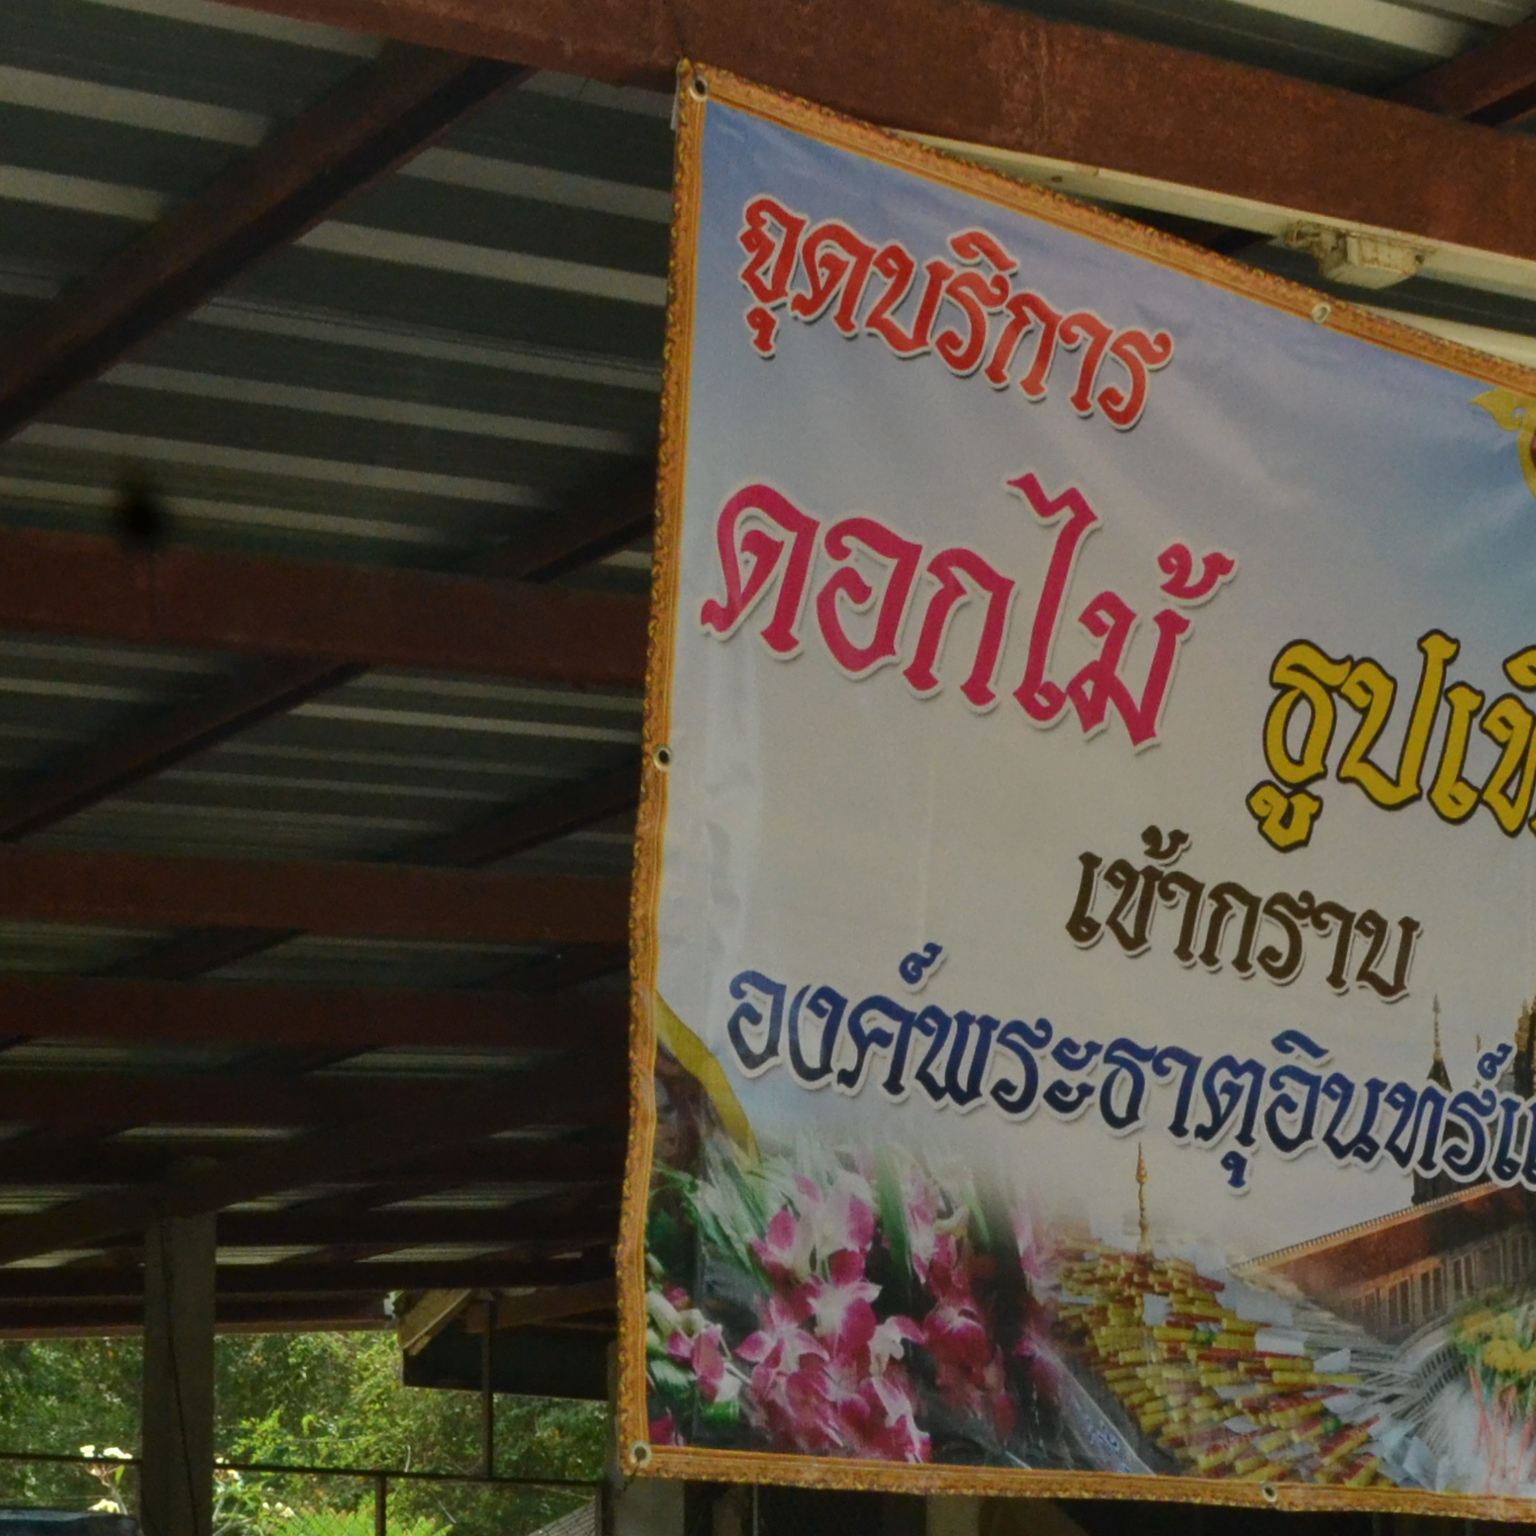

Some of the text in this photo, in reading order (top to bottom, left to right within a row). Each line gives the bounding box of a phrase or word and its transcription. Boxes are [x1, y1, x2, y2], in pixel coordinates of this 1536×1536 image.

[701, 472, 1234, 749] ดอกไม้
[1066, 825, 1421, 998] เข้ากราบ
